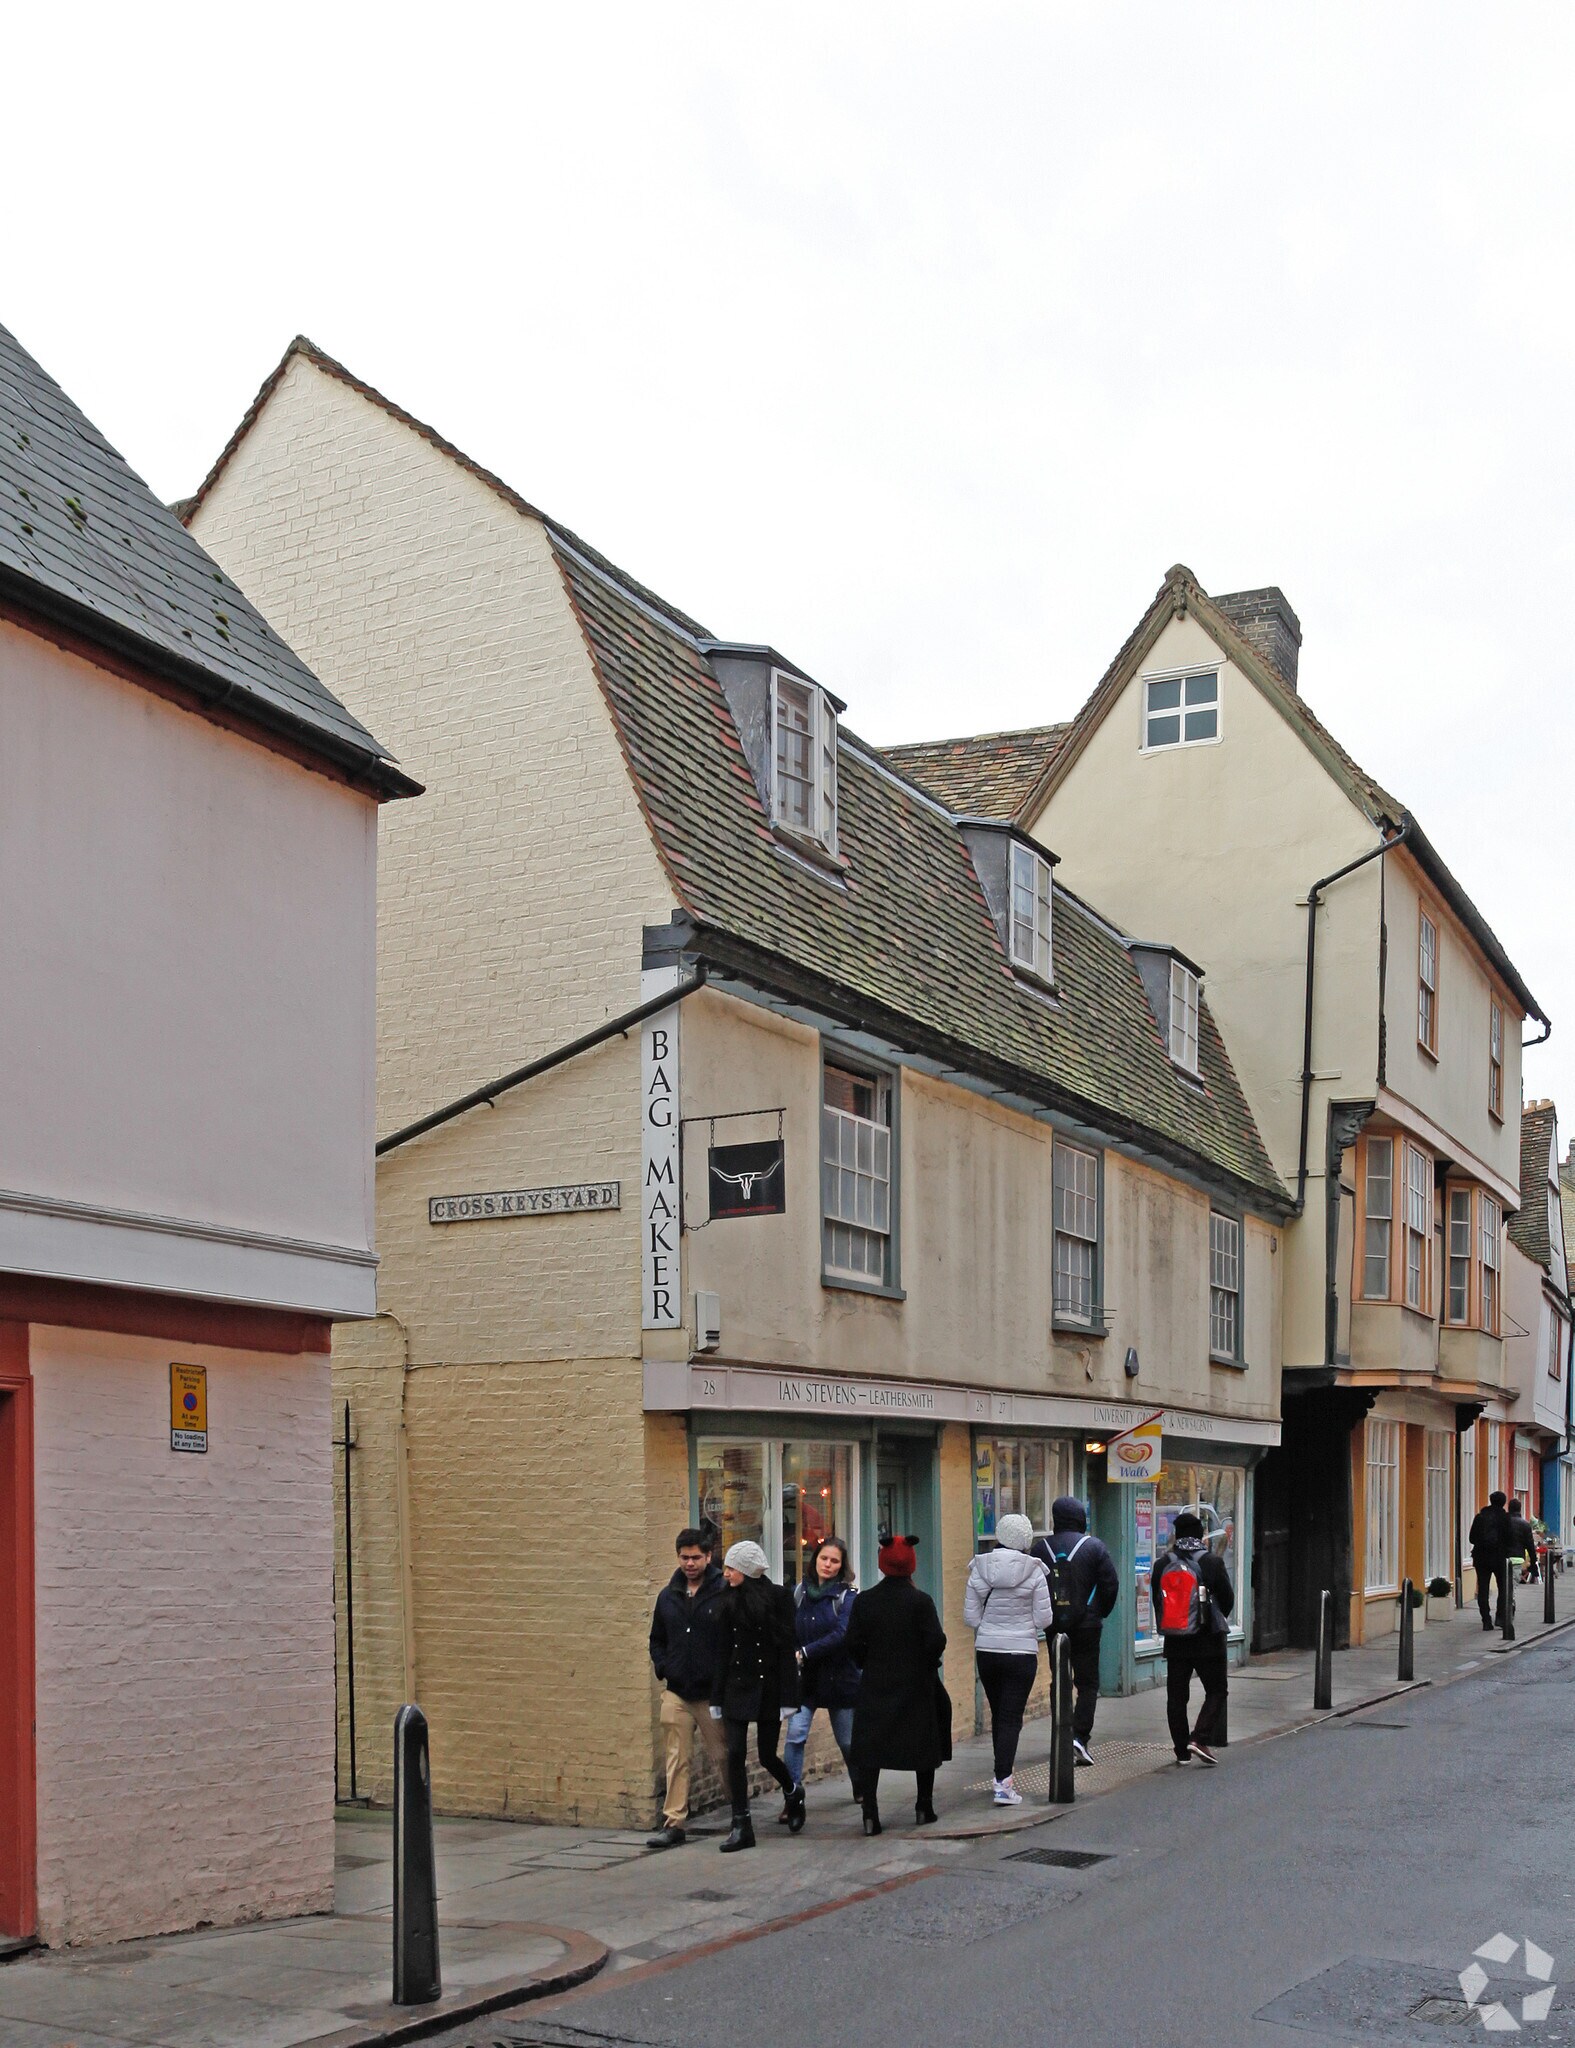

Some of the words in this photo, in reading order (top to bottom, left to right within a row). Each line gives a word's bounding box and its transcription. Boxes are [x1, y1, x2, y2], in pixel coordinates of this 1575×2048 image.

[648, 1030, 672, 1128] BAG
[434, 1198, 495, 1218] CROSS
[501, 1193, 552, 1213] KEYS
[560, 1188, 613, 1208] YARD
[645, 1155, 675, 1320] MAKER
[180, 1375, 200, 1384] Parking
[703, 1380, 716, 1395] 28
[779, 1381, 800, 1401] IAN
[806, 1382, 856, 1405] STEVENS
[869, 1389, 934, 1409] LEATHERSMITH
[1093, 1407, 1135, 1424] UNIVERSITY
[1169, 1416, 1176, 1429] &
[1177, 1417, 1214, 1433] NEWSAGENTS
[184, 1433, 205, 1442] loading
